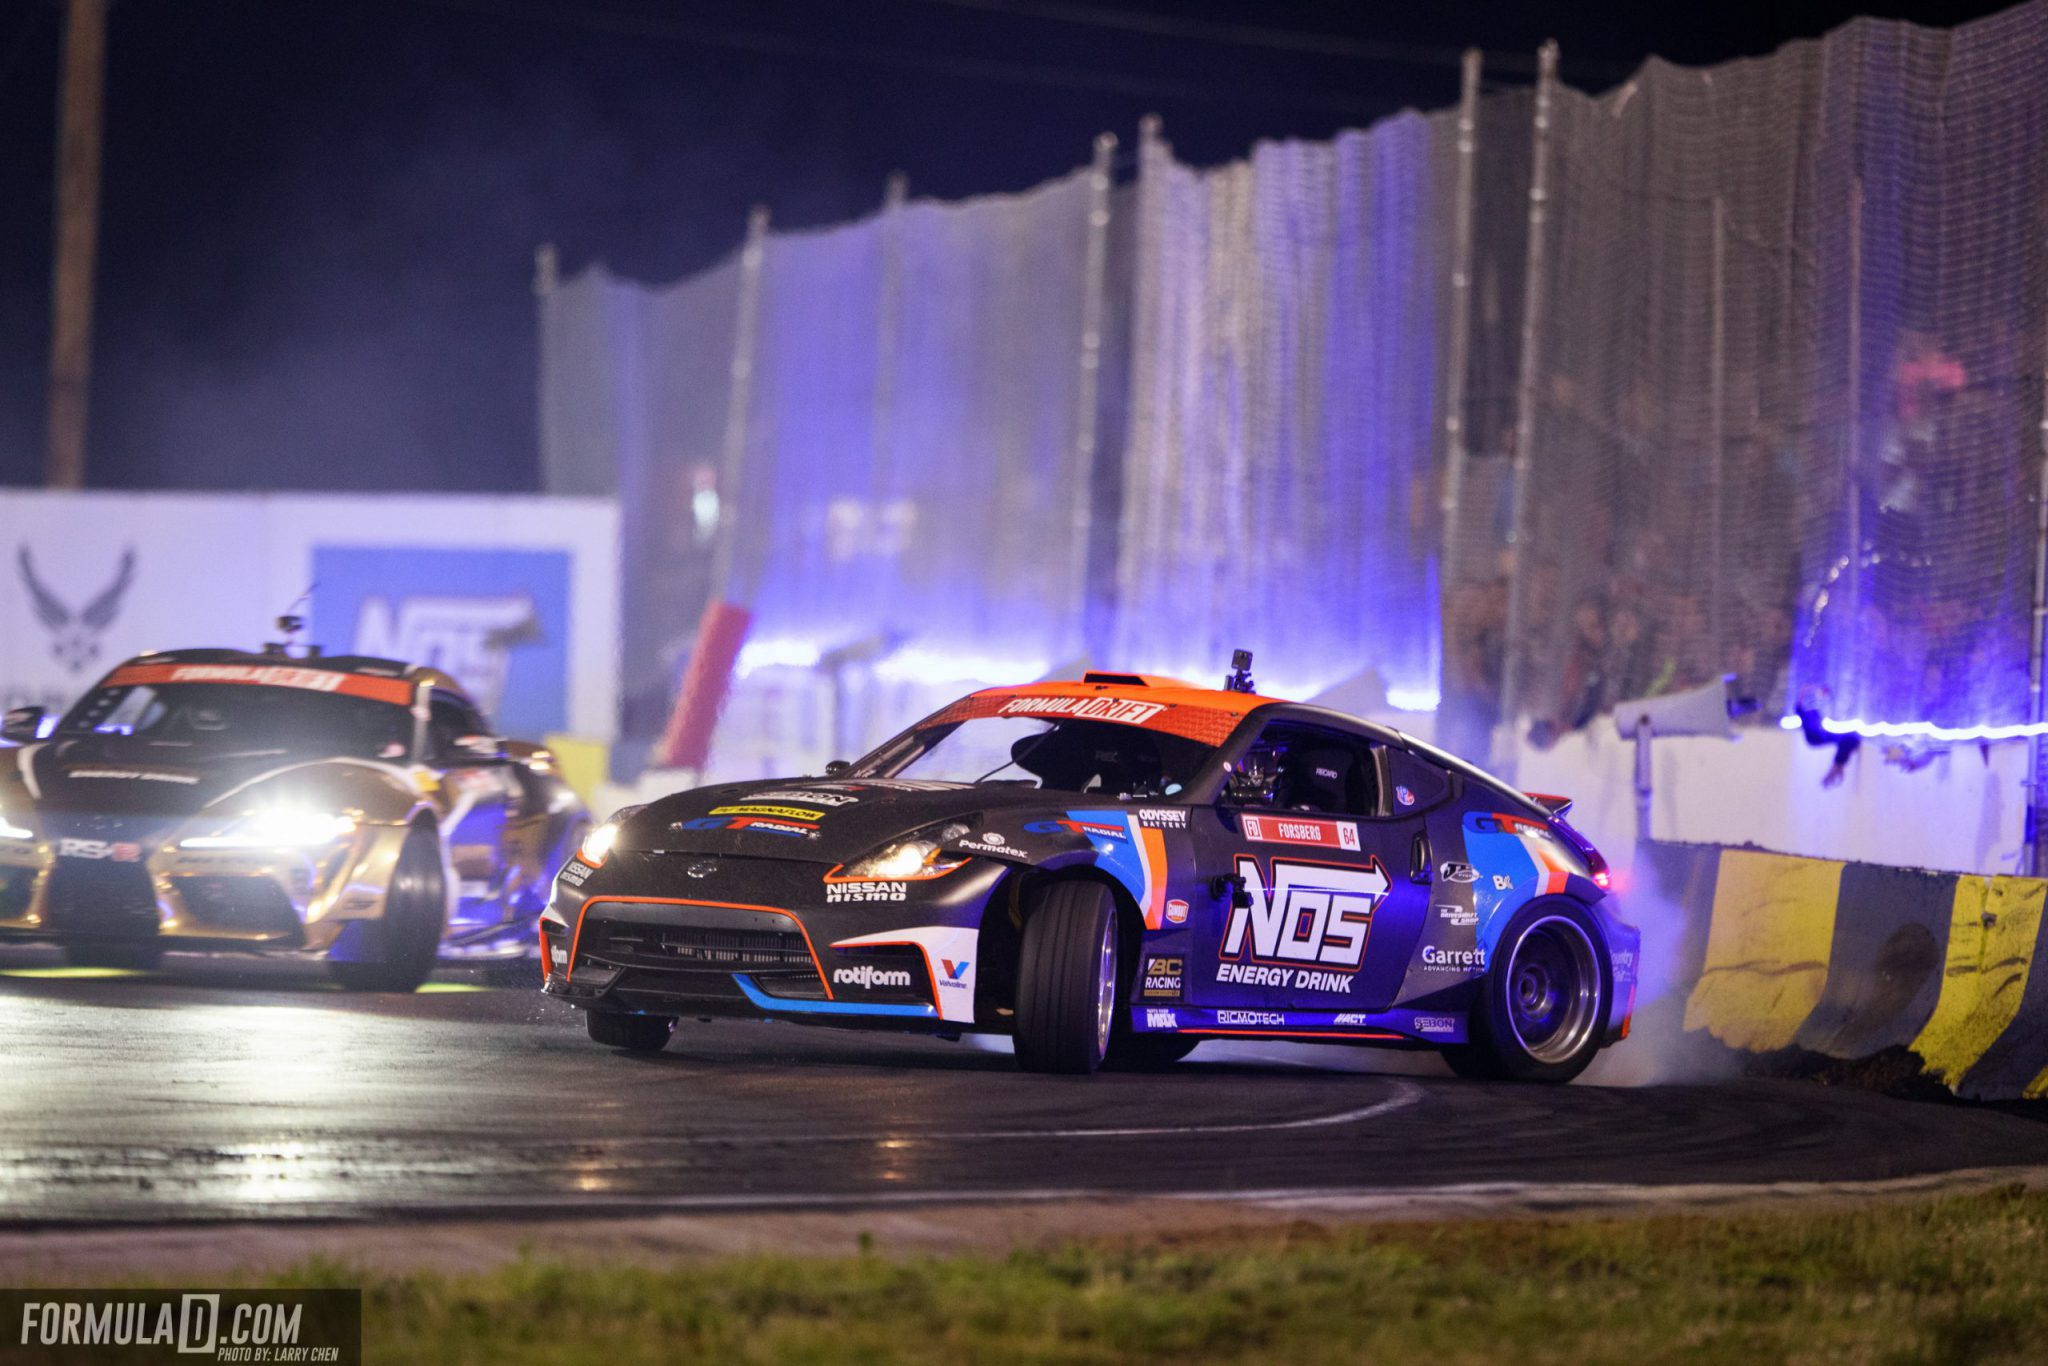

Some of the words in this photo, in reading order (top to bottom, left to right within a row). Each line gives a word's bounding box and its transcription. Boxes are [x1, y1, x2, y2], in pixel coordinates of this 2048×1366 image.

[1139, 809, 1186, 822] ODYSSEY
[750, 821, 809, 835] RADIAL
[1082, 826, 1127, 839] RADIAL
[1143, 821, 1186, 829] BATTERY
[1278, 823, 1322, 840] FORSBERG
[1343, 828, 1356, 845] 64
[959, 839, 1028, 858] Permatex
[827, 882, 907, 893] NISSAN
[827, 893, 907, 903] nismo
[1224, 856, 1390, 964] NOS
[1422, 945, 1486, 966] Garrett
[833, 965, 911, 989] rotiform
[1145, 977, 1181, 989] RACING
[1216, 964, 1296, 988] ENERGY
[1295, 971, 1354, 994] DRINK
[1146, 1012, 1178, 1028] MAX
[1217, 1009, 1285, 1026] RICMOTECH
